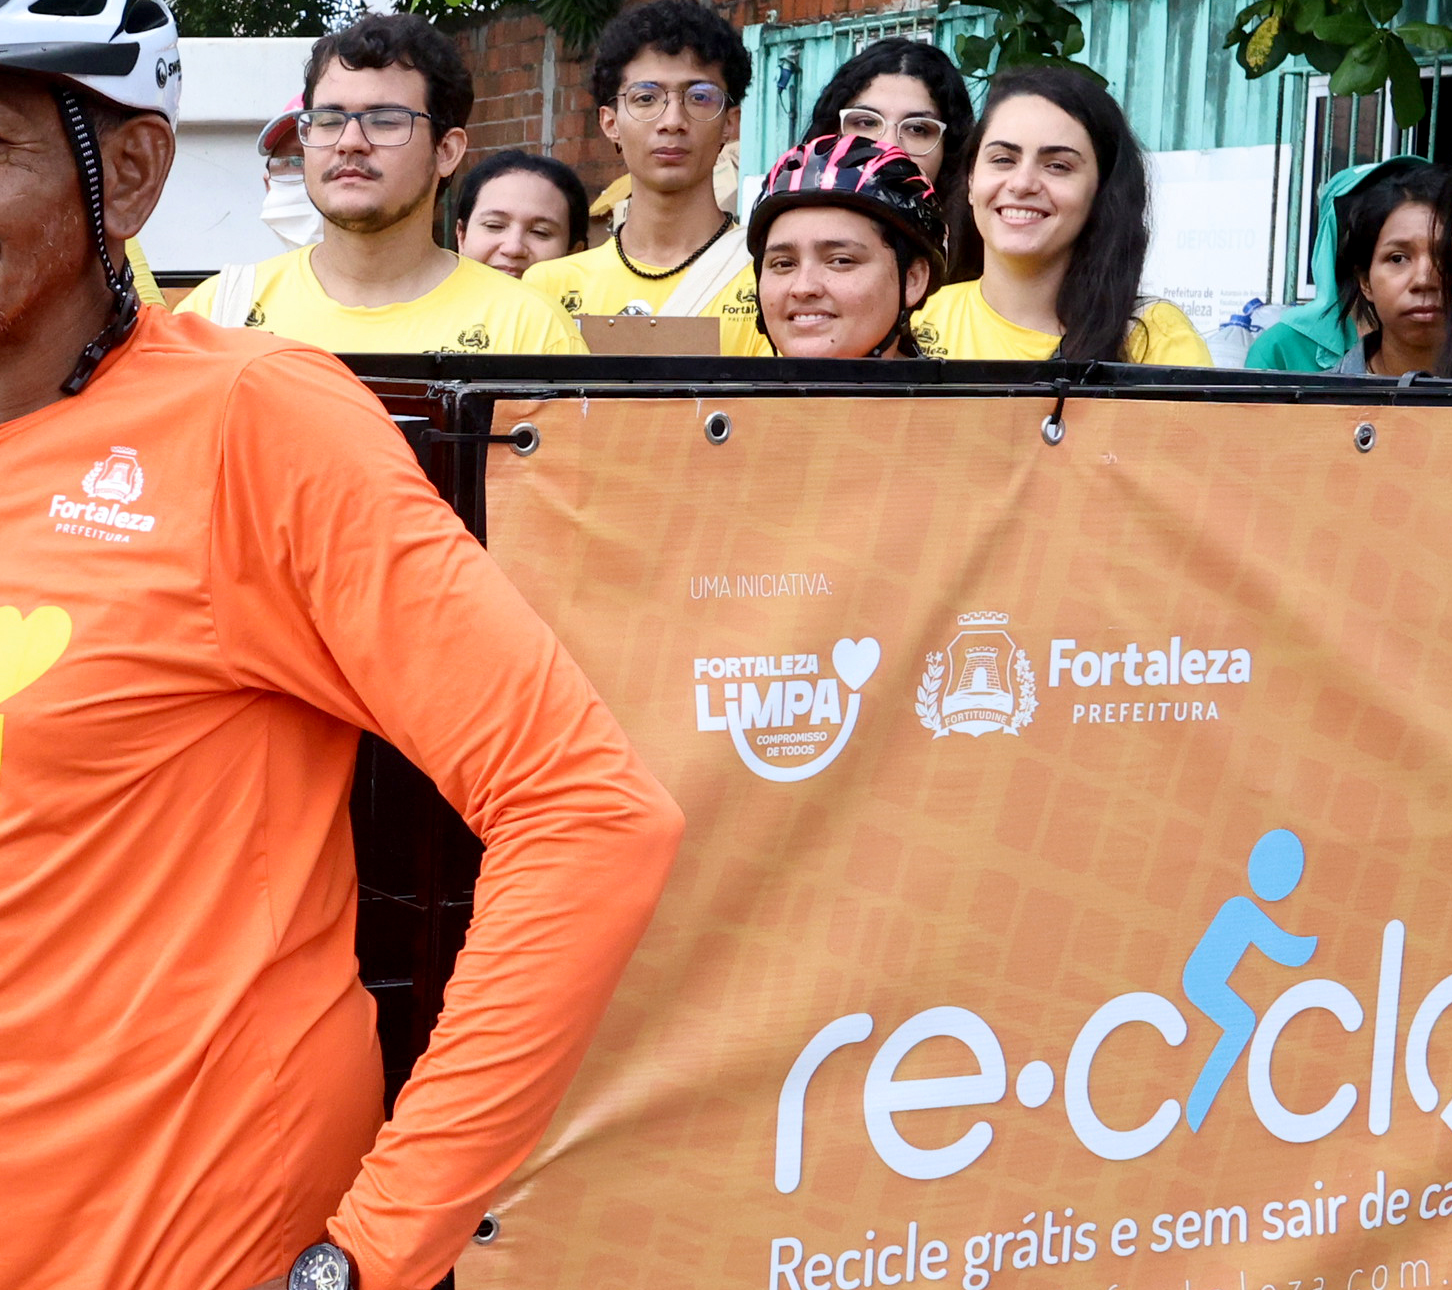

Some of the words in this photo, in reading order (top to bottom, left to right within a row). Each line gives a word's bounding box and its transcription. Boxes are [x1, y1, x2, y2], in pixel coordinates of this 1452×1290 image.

[1163, 287, 1202, 299] Prefeitura
[1203, 287, 1214, 299] de
[1182, 300, 1213, 317] taleza
[48, 494, 155, 532] Fortaleza
[55, 523, 131, 543] PREFEITURA
[690, 576, 732, 599] UMA
[736, 573, 833, 597] INICIATIVA:
[694, 654, 819, 679] FORTALEZA
[1048, 636, 1252, 687] Fortaleza
[944, 710, 1008, 727] FORTITUDINE
[1072, 701, 1220, 724] PREFEITURA
[756, 731, 828, 745] COMPROMISSO
[766, 747, 779, 757] DE
[780, 745, 815, 756] TODOS
[1110, 1217, 1138, 1258] e
[1150, 1204, 1248, 1252] sem
[1262, 1180, 1348, 1241] sair
[1359, 1170, 1410, 1230] de
